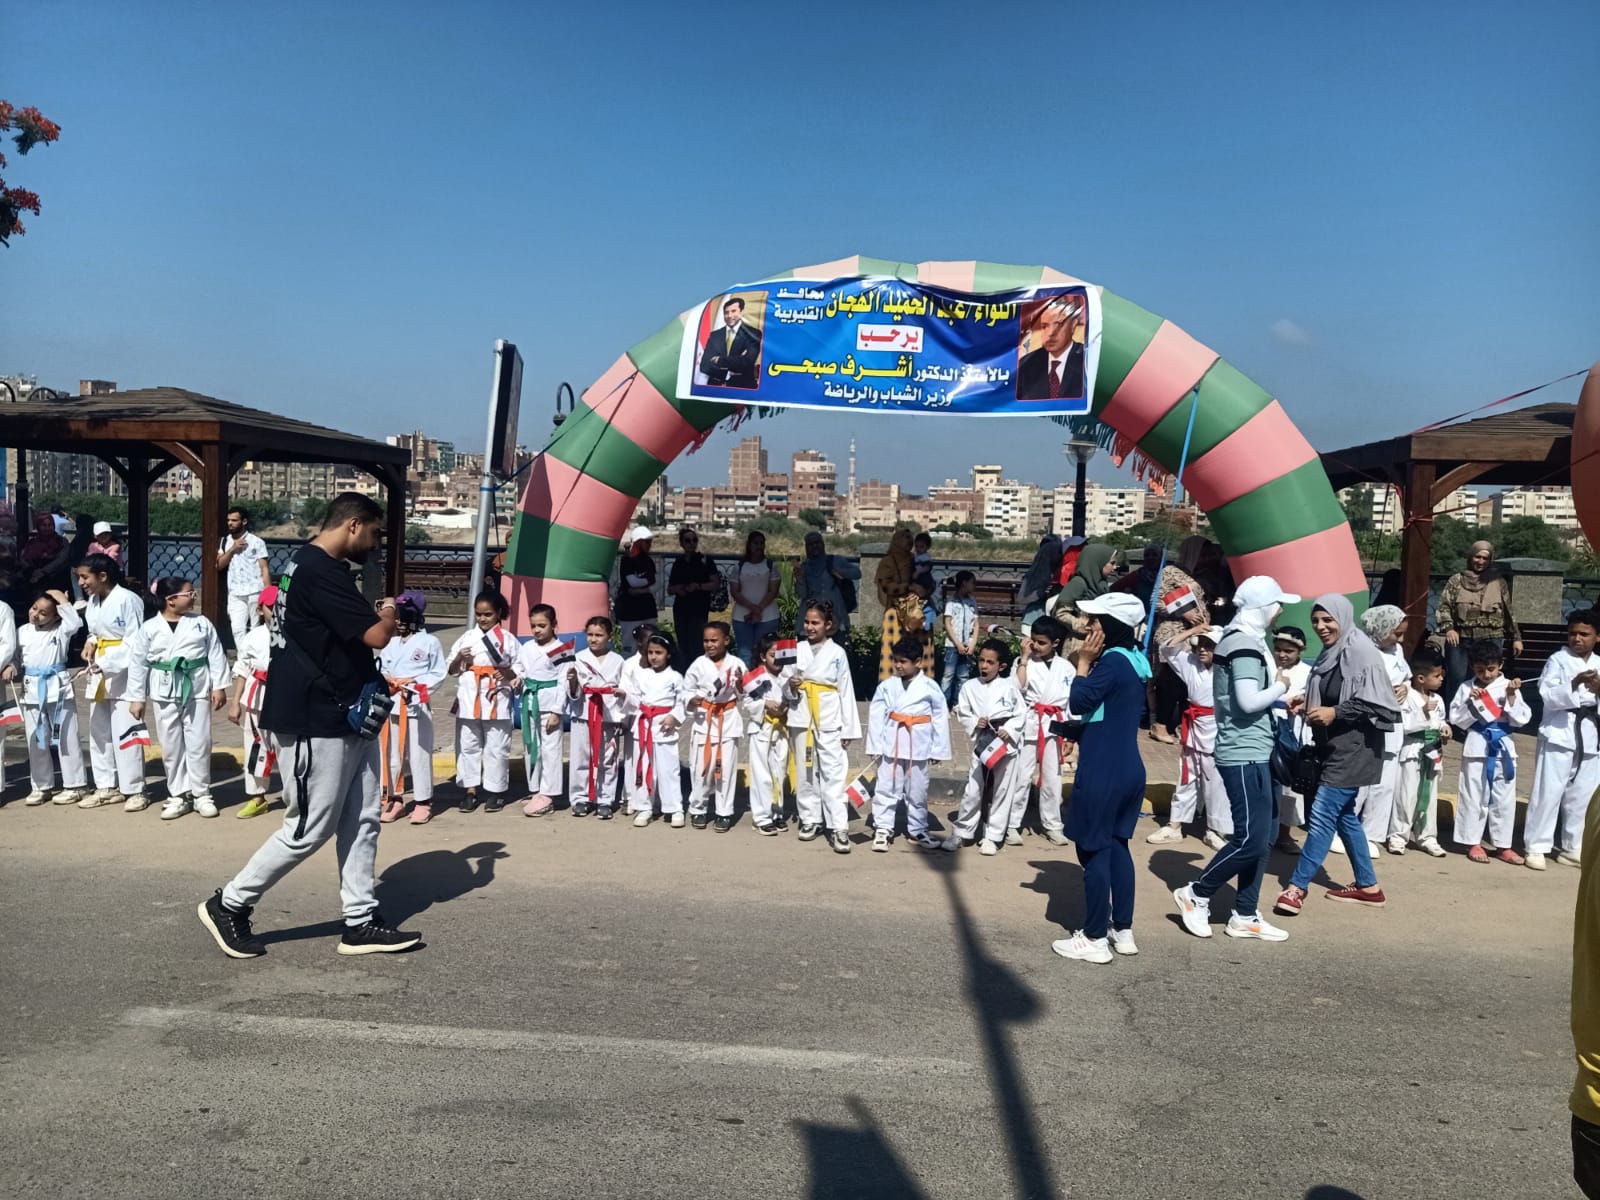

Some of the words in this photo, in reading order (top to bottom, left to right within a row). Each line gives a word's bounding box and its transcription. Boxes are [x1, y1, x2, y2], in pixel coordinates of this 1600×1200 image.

[773, 304, 824, 324] القليوبية
[825, 290, 881, 319] الهجان
[883, 292, 934, 321] الحميد
[861, 329, 918, 350] يرحب
[840, 354, 913, 381] أشرف
[913, 365, 958, 382] الدكتور
[824, 381, 879, 404] والرياضة
[880, 384, 922, 405] الشباب
[922, 388, 954, 407] وزير
